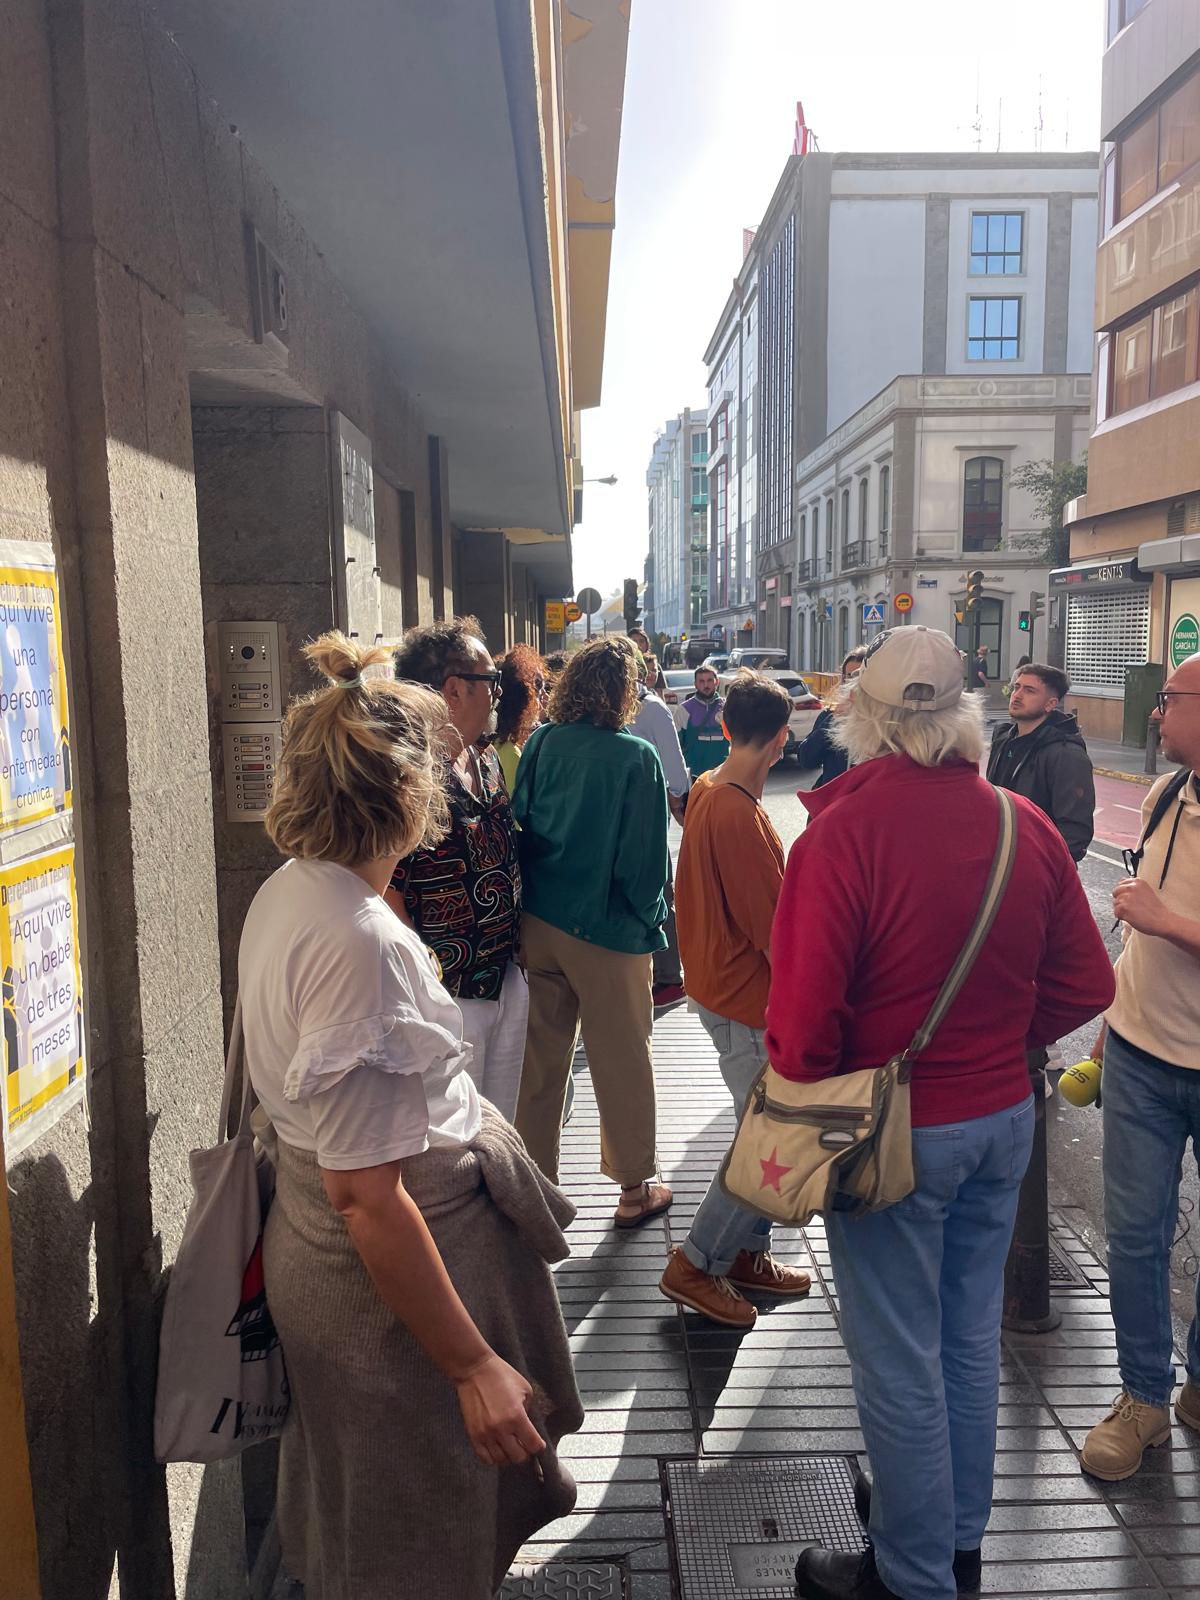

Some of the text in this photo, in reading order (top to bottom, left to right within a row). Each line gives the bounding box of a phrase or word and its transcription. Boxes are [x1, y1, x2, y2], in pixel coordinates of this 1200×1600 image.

[1098, 565, 1123, 581] KENT'S
[0, 599, 54, 629] quí vive
[13, 647, 37, 667] una
[0, 688, 55, 719] persona
[20, 727, 40, 743] con
[2, 752, 62, 780] enfermedad
[16, 785, 53, 809] crónica.
[13, 901, 72, 944] Aquí vive
[19, 936, 72, 984] un bebé
[26, 983, 73, 1024] de tres
[32, 1023, 71, 1065] meses
[753, 1554, 797, 1565] RAFICO
[755, 1567, 796, 1580] EÑALES
